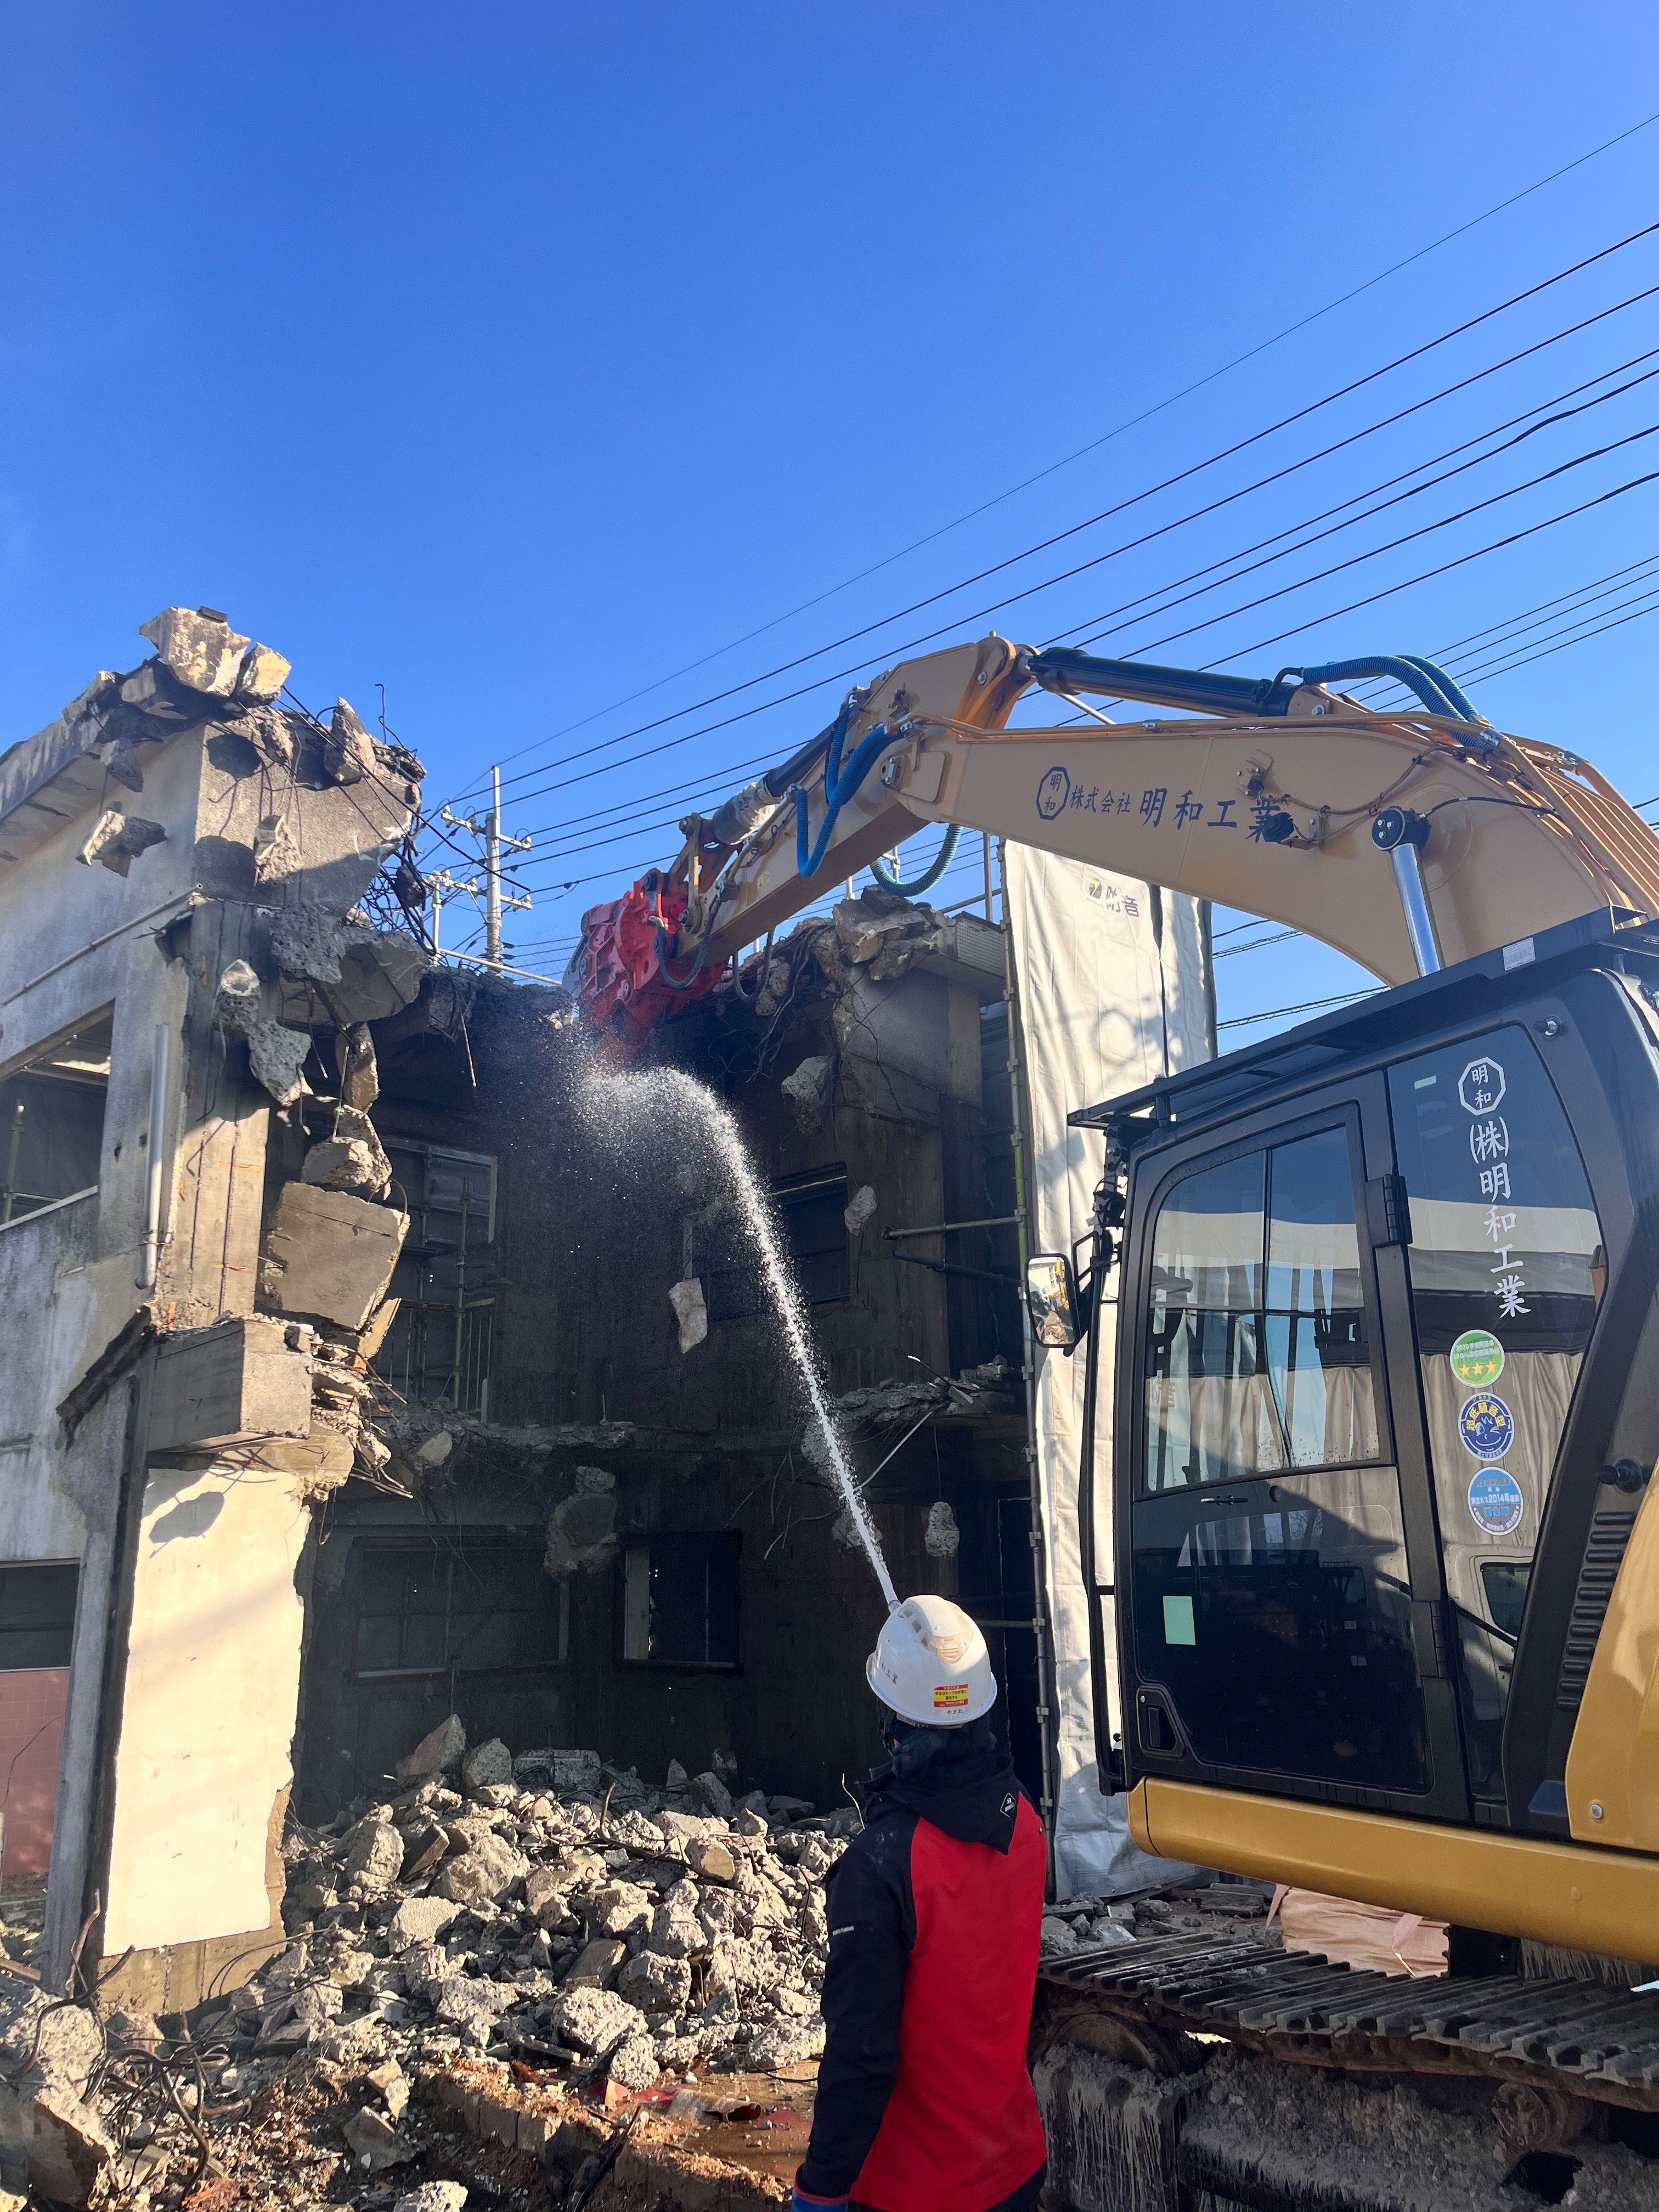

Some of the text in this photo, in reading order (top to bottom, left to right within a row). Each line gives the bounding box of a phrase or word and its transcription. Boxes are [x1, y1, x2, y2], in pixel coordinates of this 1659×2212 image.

[1045, 773, 1062, 812] 明和
[1471, 1064, 1492, 1109] 明和
[1469, 1116, 1532, 1318] (株)明和工業
